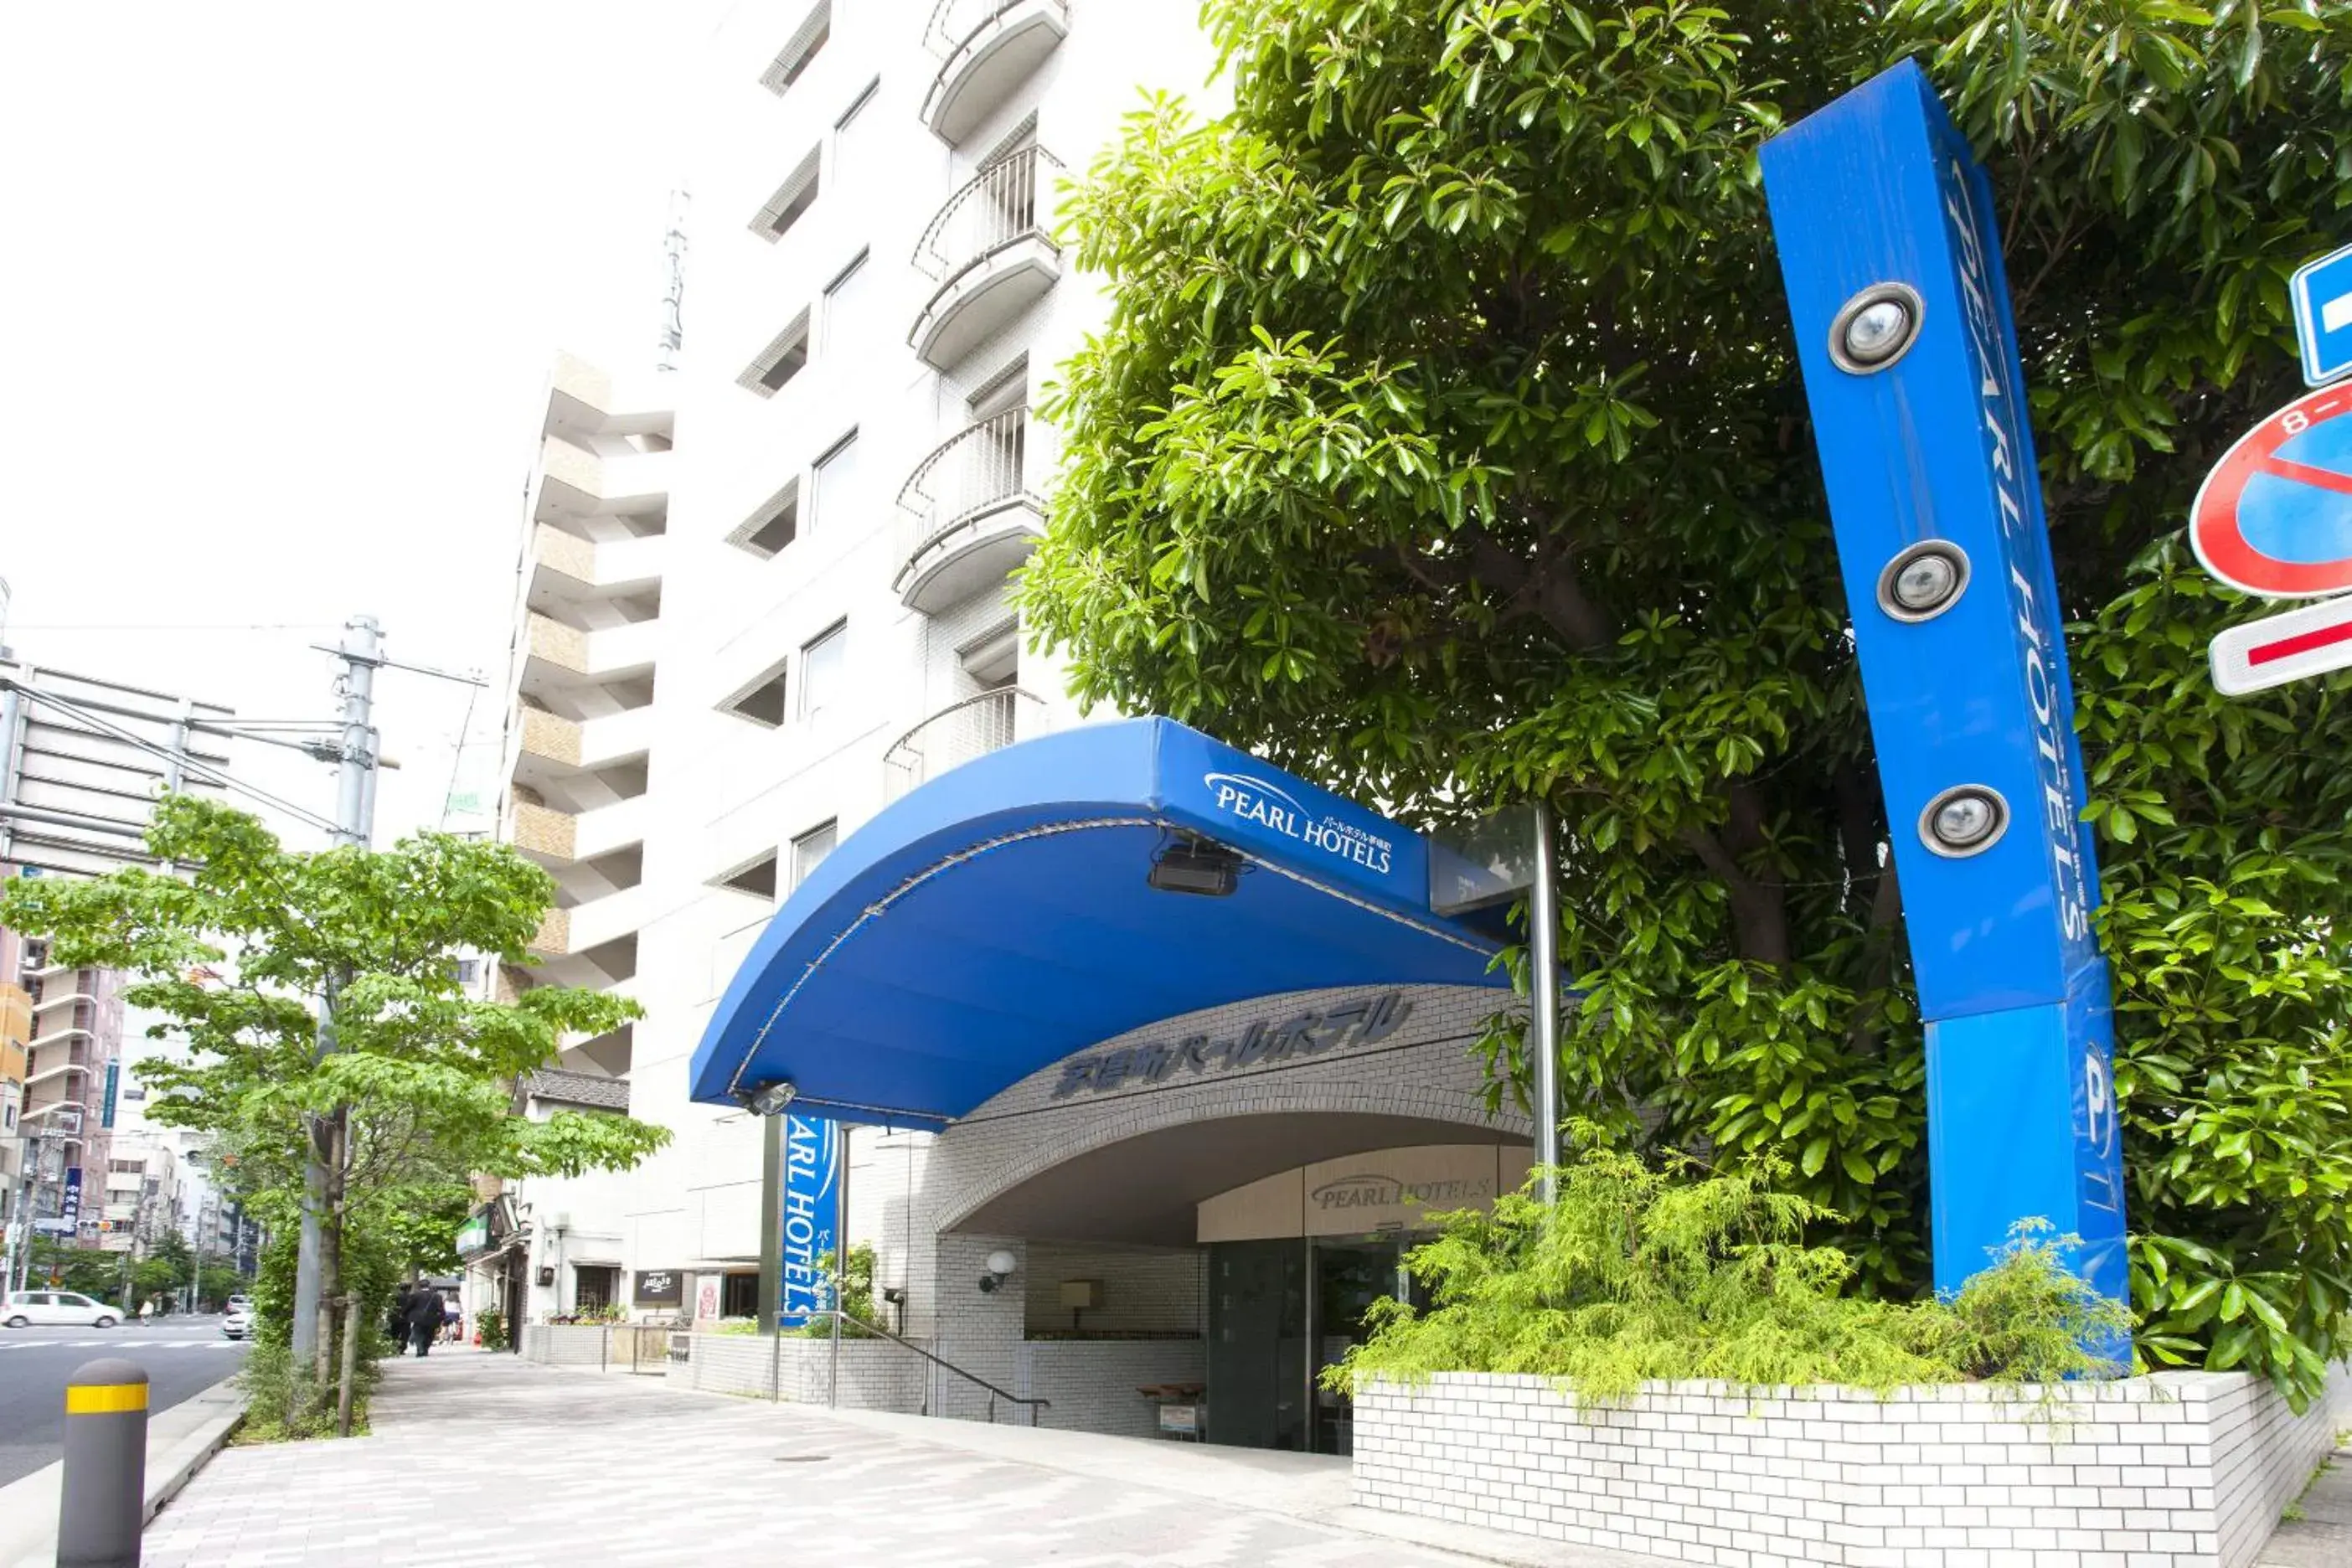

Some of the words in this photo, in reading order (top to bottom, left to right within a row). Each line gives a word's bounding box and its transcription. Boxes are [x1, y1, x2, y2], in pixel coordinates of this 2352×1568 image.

[1945, 189, 2021, 539] PEARL
[2009, 561, 2083, 942] HOTELS
[1216, 783, 1300, 839] PEARL
[1303, 819, 1392, 875] HOTELS
[1321, 1186, 1390, 1210] PEARL
